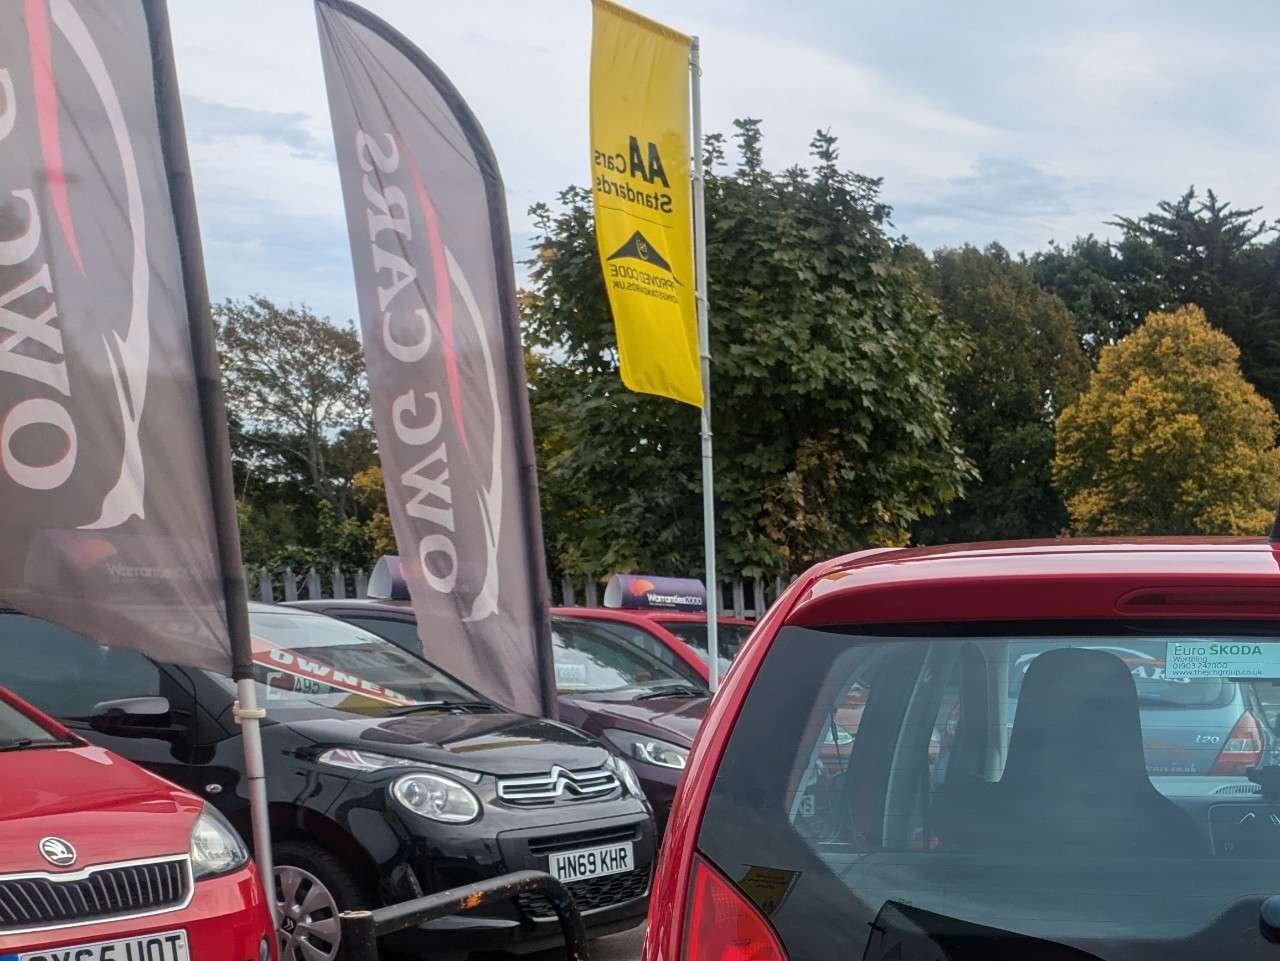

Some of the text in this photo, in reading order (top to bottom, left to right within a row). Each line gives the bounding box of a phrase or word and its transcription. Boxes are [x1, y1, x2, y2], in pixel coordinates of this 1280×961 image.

[1174, 643, 1262, 656] Euro ŠKODA
[556, 847, 628, 880] HN69 KHR
